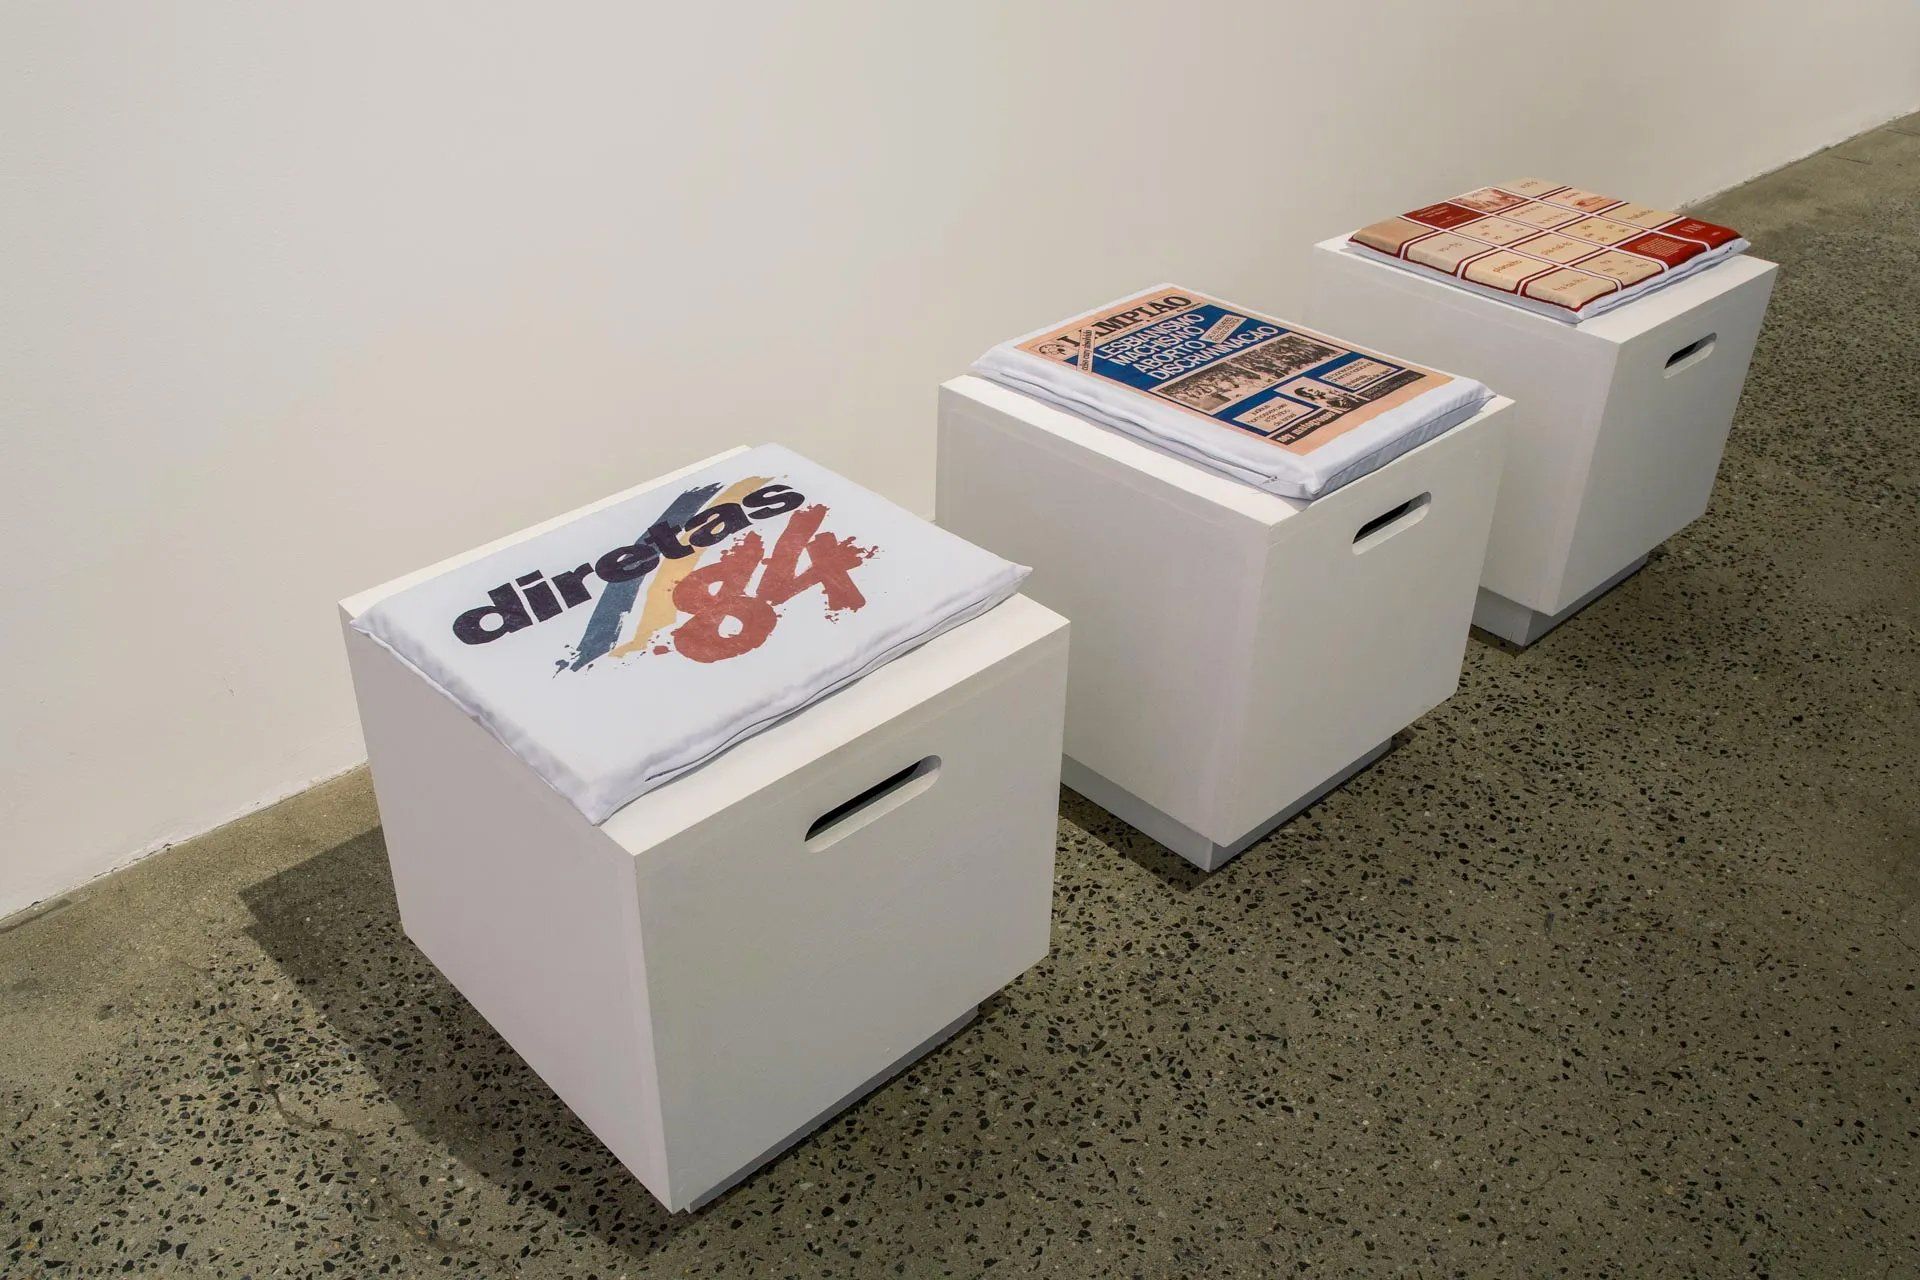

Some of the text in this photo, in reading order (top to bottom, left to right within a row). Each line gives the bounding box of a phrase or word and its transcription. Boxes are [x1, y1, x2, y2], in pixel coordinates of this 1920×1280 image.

[1094, 313, 1205, 359] LESBIANISMO
[1109, 325, 1205, 366] MACHISMO
[1132, 340, 1206, 373] ABORTO
[453, 484, 805, 645] diretas
[672, 503, 867, 663] 84
